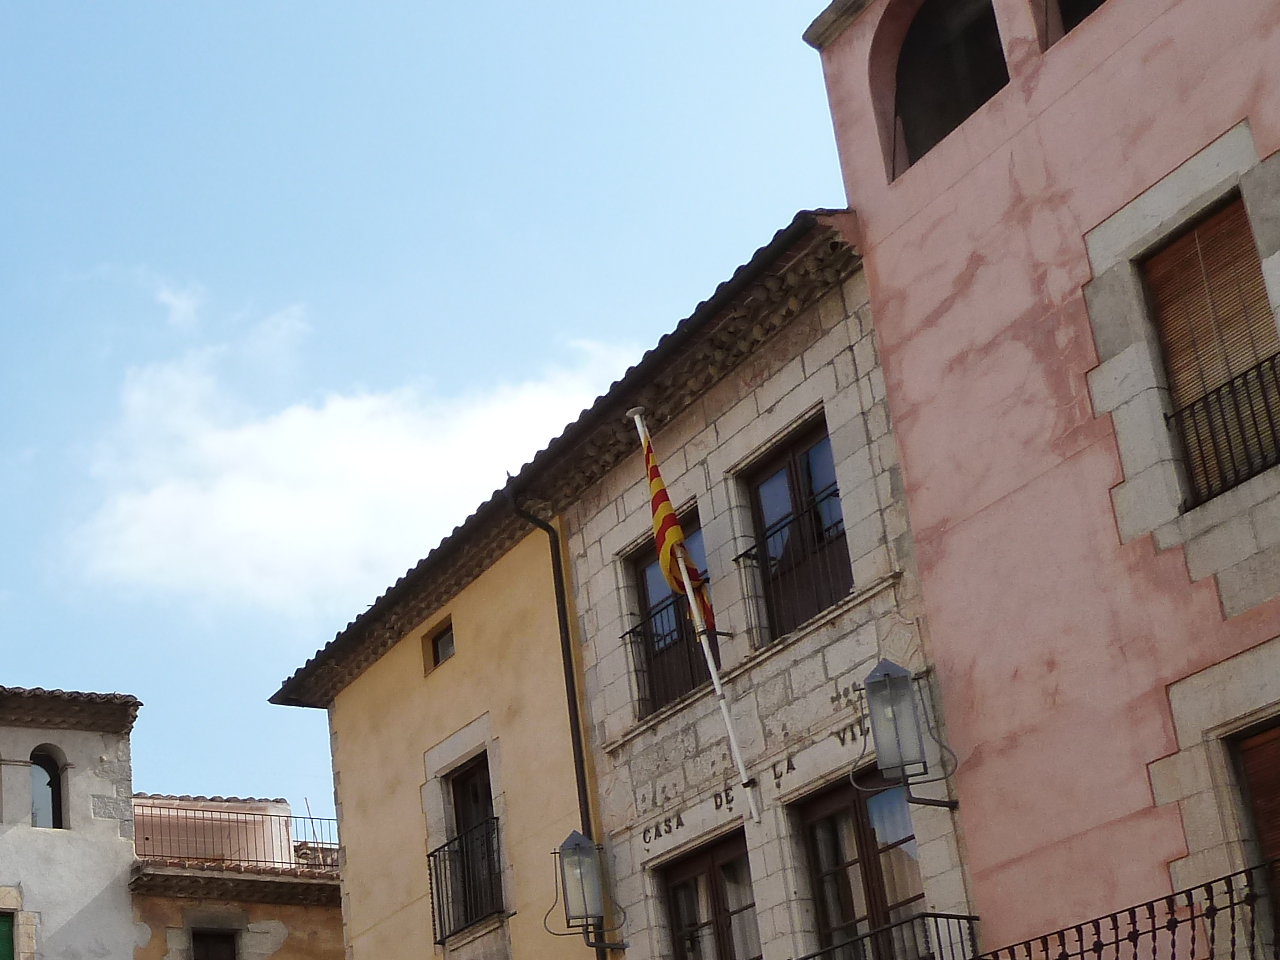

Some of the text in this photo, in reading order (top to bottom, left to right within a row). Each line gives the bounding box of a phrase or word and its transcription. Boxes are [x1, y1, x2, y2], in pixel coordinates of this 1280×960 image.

[642, 813, 685, 844] CASA
[713, 787, 735, 811] DE
[772, 757, 796, 780] LA
